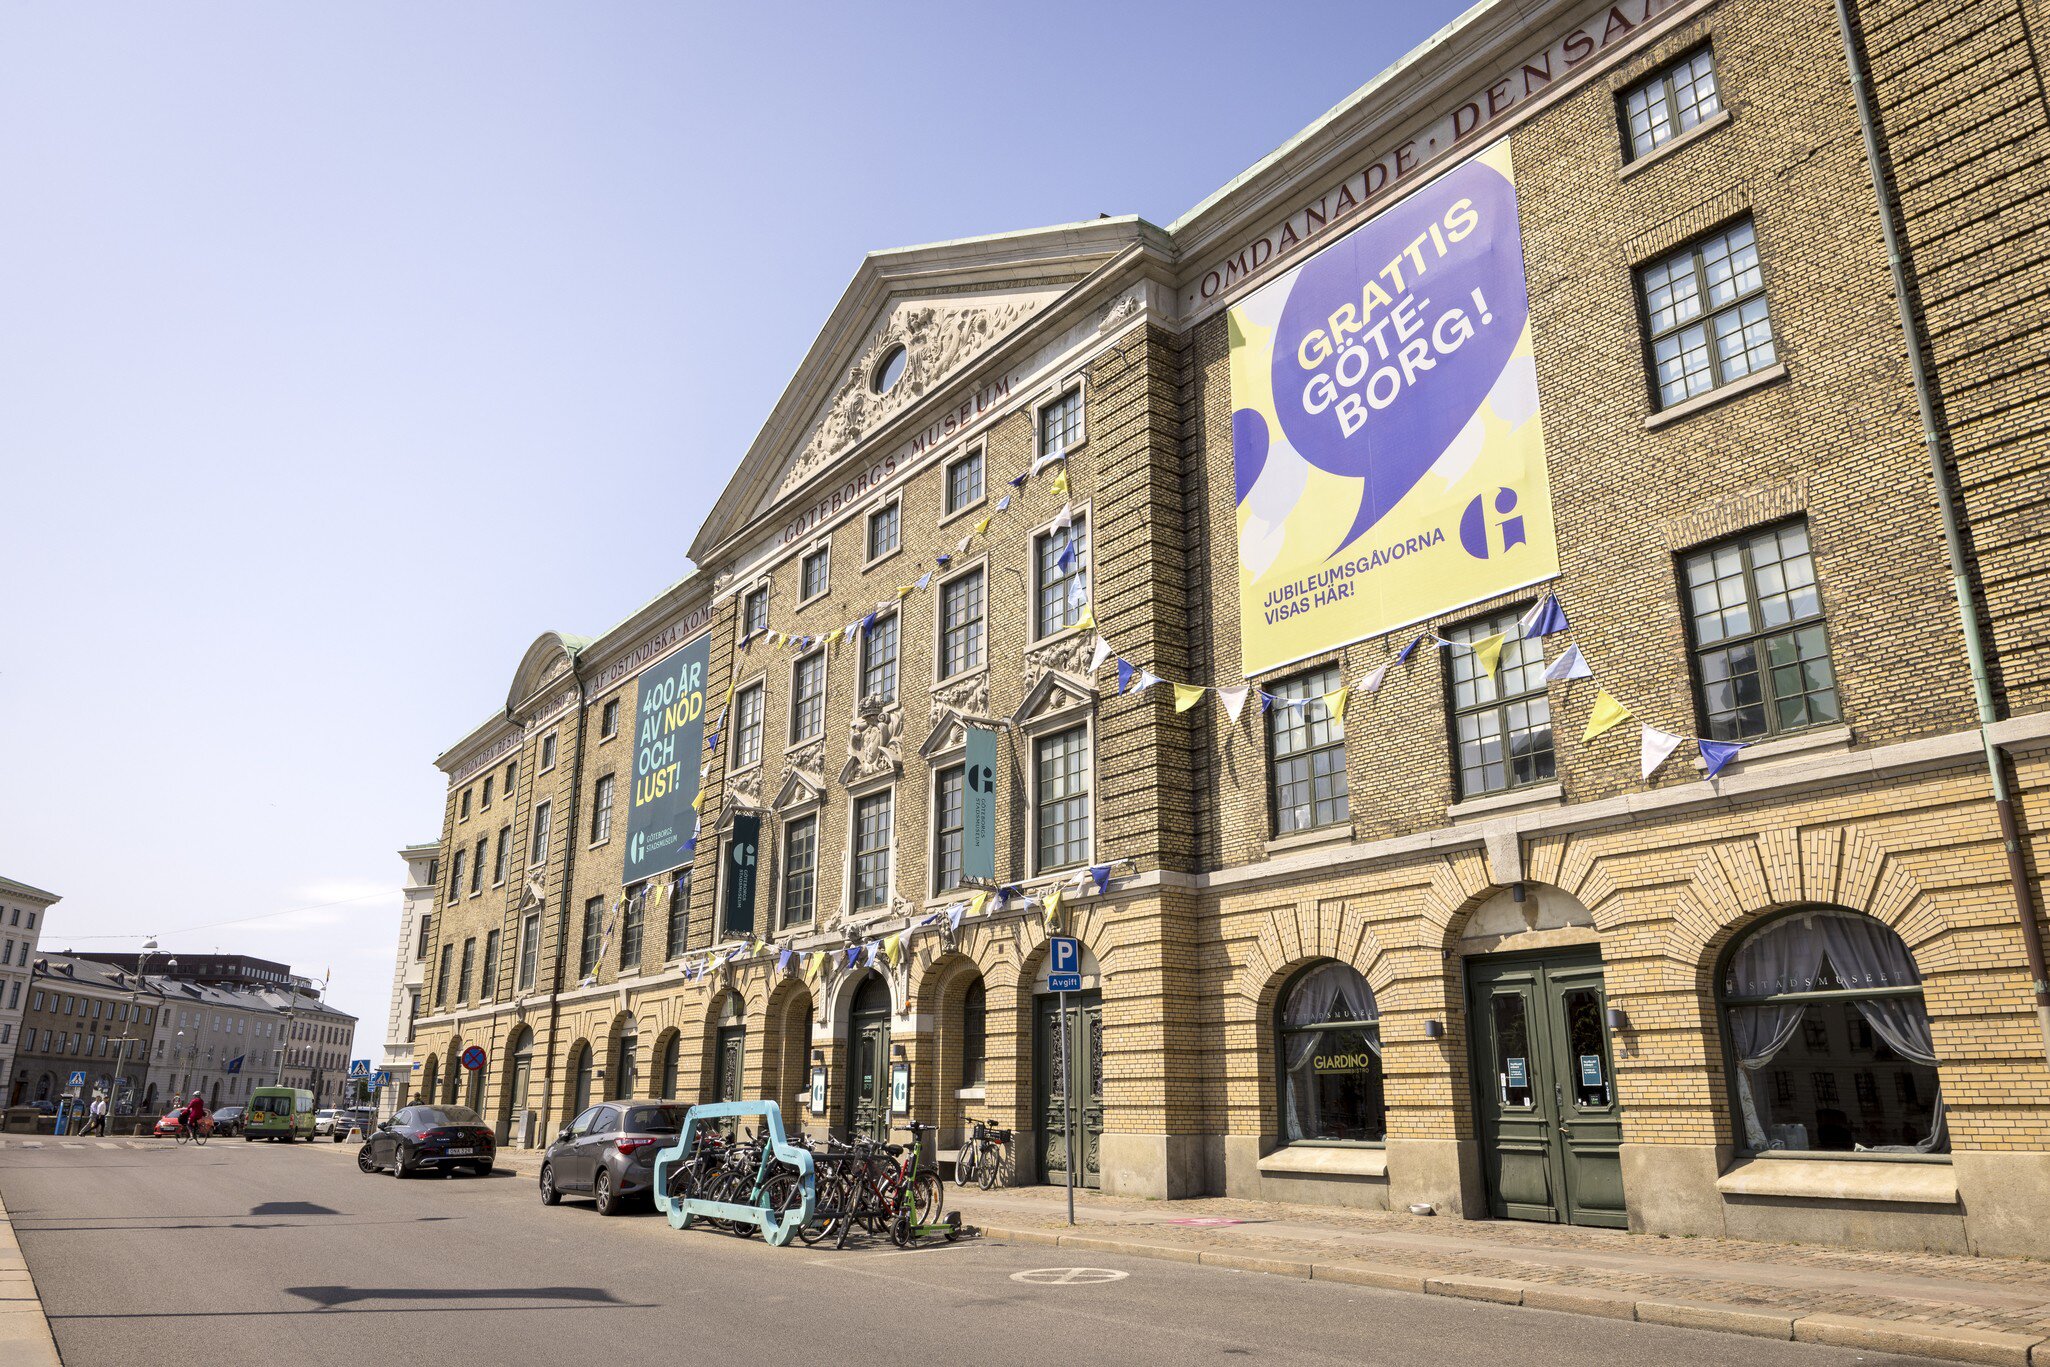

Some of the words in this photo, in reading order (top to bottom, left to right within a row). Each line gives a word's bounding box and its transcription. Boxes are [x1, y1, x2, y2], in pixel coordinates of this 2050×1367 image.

[1200, 143, 1419, 300] OMDANADE
[1297, 198, 1480, 371] GRATTIS
[1302, 291, 1432, 415] GÖTE-
[1334, 286, 1494, 440] BORG!
[909, 375, 1012, 462] MUSEUM
[1264, 527, 1446, 609] JUBILEUMSGÅVORNA
[1264, 592, 1311, 625] VISAS
[1314, 581, 1355, 609] HÄR!
[611, 627, 677, 680] OSTINDISKA
[682, 604, 714, 636] KOM
[642, 676, 675, 715] 400
[676, 661, 702, 700] ÅR
[640, 711, 664, 748] AV
[663, 691, 703, 735] NÖD
[638, 733, 675, 776] OCH
[635, 761, 681, 807] LUST!
[1057, 941, 1073, 969] P
[1749, 971, 1902, 989] STADSMUSEET
[1052, 978, 1077, 988] Avgift
[1313, 1053, 1369, 1069] GIARDINO
